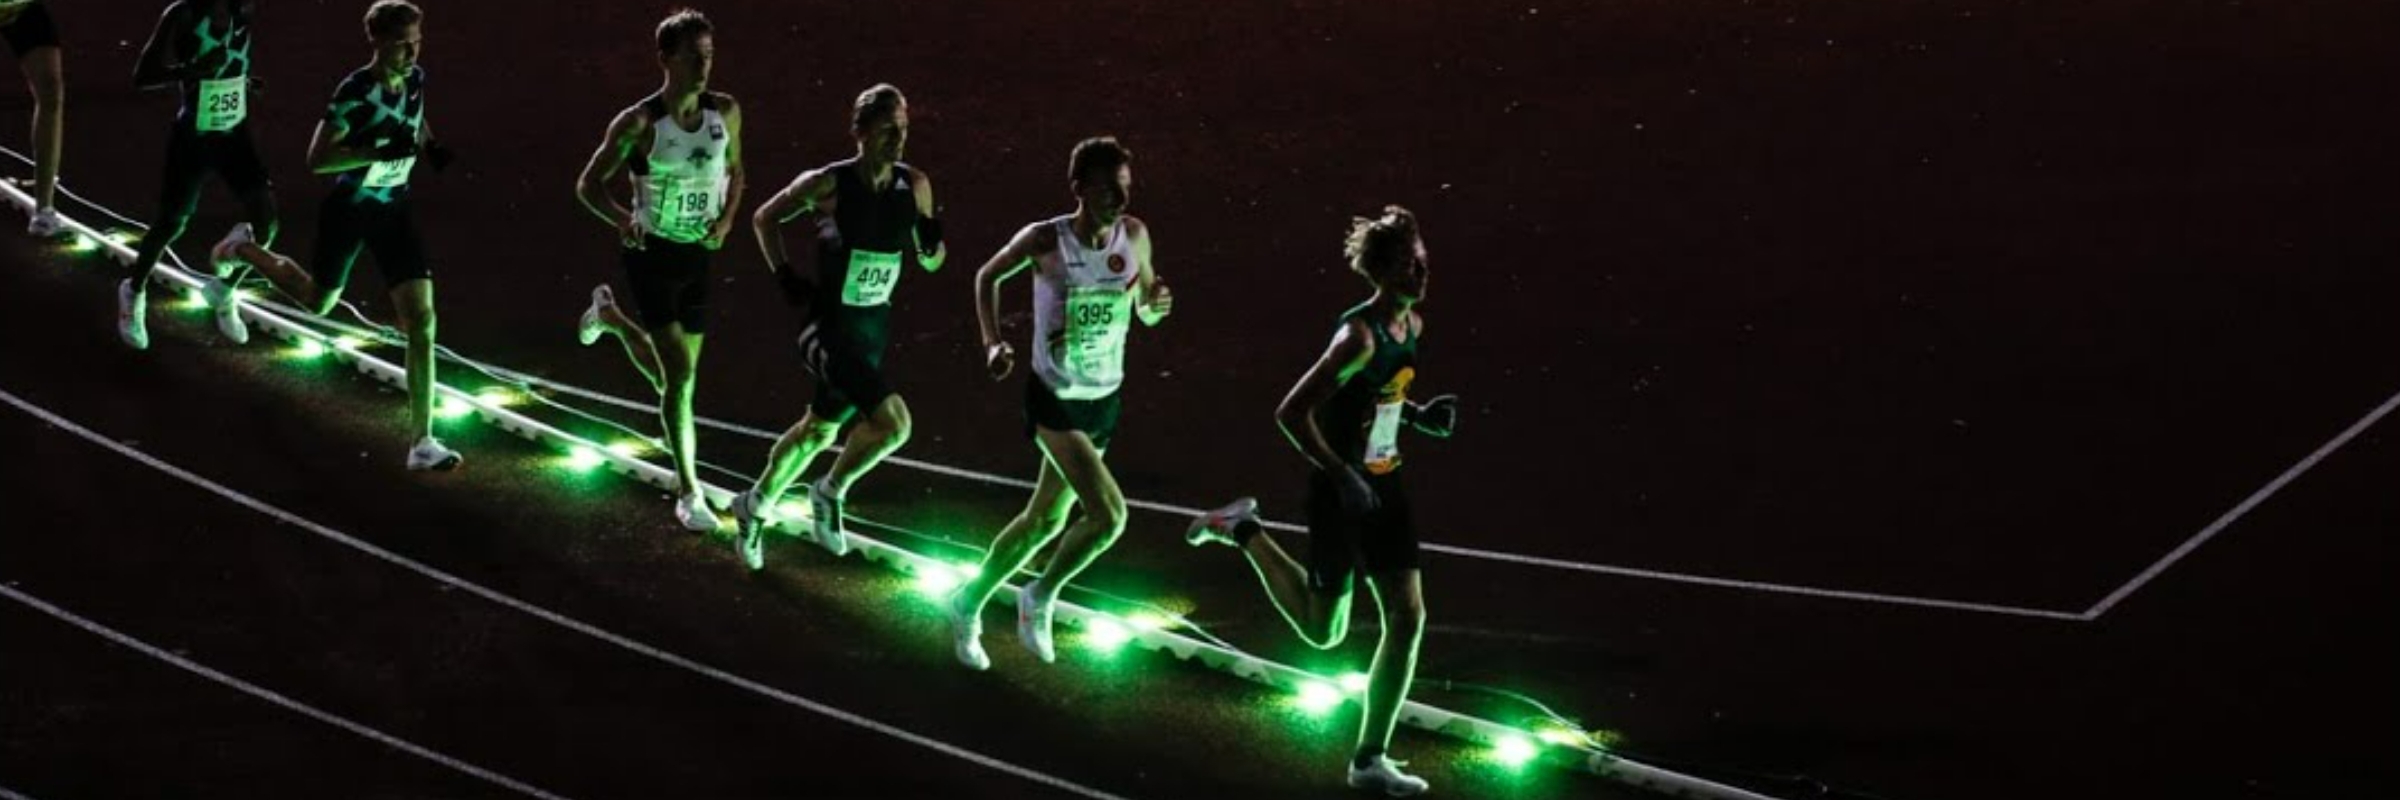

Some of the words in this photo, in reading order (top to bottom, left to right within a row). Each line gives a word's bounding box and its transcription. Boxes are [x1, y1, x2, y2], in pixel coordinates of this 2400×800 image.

[209, 91, 240, 113] 258
[678, 192, 708, 212] 198
[857, 267, 892, 287] 404
[1078, 303, 1113, 326] 395
